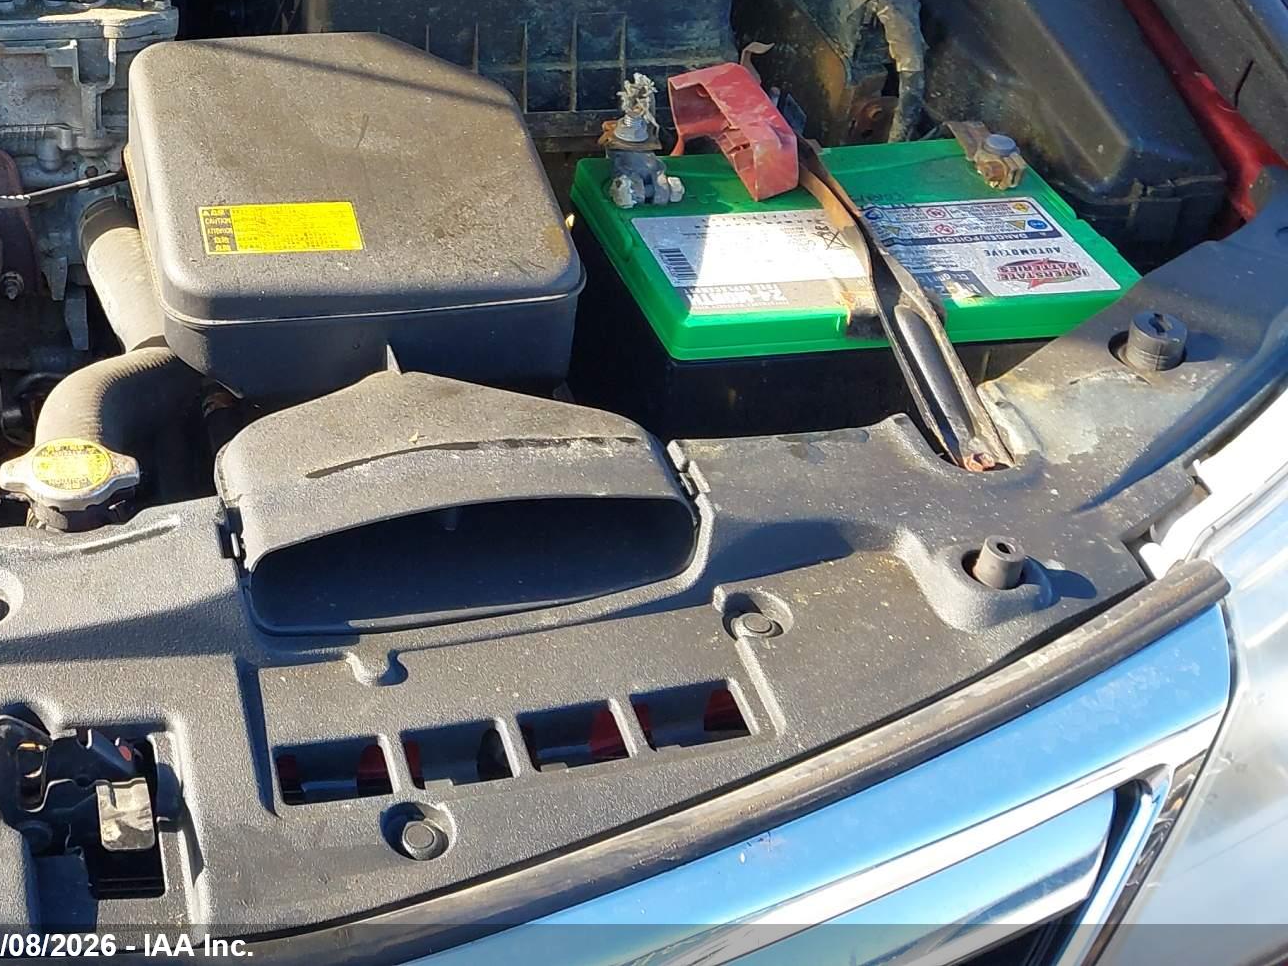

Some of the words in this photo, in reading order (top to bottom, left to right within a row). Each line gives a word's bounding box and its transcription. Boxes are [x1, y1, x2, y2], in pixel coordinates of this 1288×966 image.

[937, 233, 1028, 243] DANGER/POISON
[983, 246, 1061, 257] AUTOMOTIVE
[996, 261, 1080, 274] BATTERIES
[995, 268, 1090, 282] INTERSTATE
